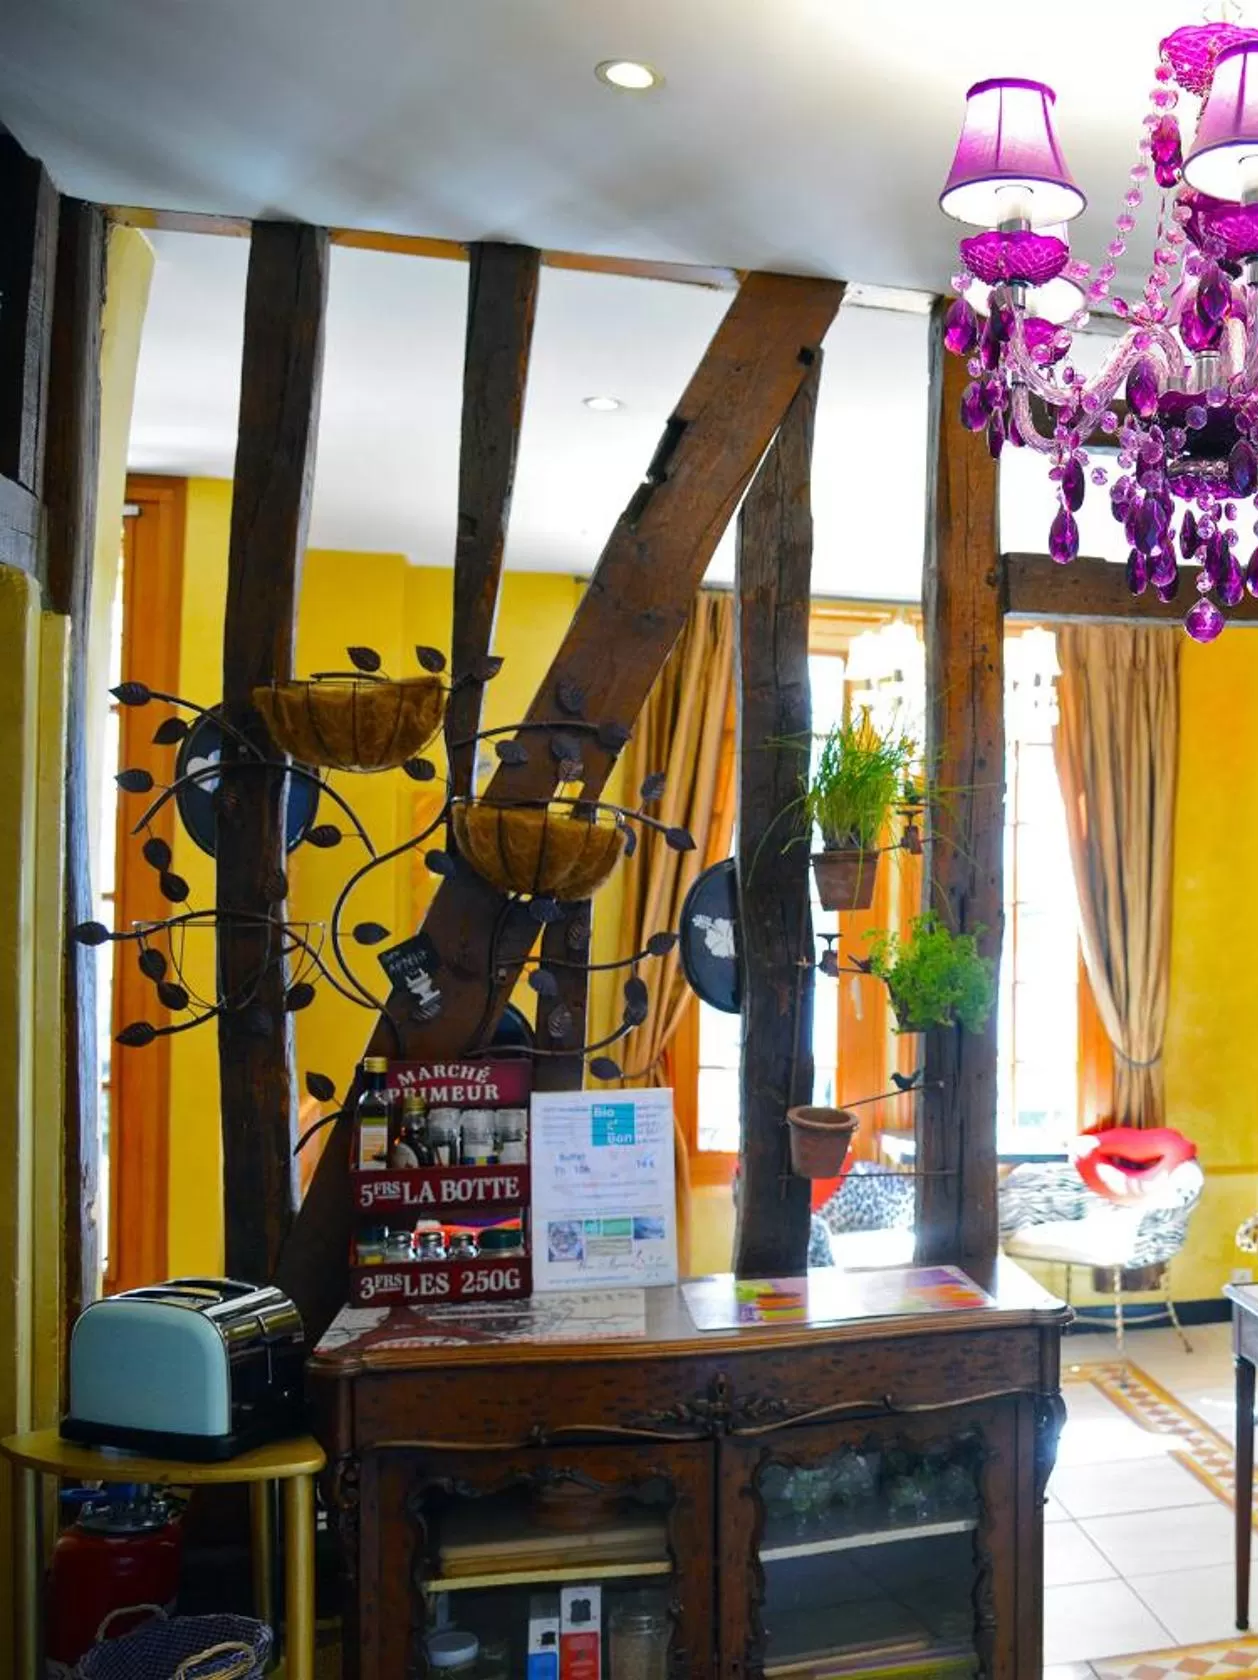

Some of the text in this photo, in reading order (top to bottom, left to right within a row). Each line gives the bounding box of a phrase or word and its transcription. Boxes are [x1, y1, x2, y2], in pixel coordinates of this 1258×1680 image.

[397, 1064, 492, 1087] MARCHÉ
[387, 1083, 499, 1103] PRIMEUR
[593, 1105, 615, 1117] Bio
[606, 1135, 634, 1144] Bon
[402, 1181, 436, 1204] LA
[440, 1176, 520, 1201] BOTTE
[403, 1273, 449, 1297] LES
[461, 1268, 521, 1293] 250G
